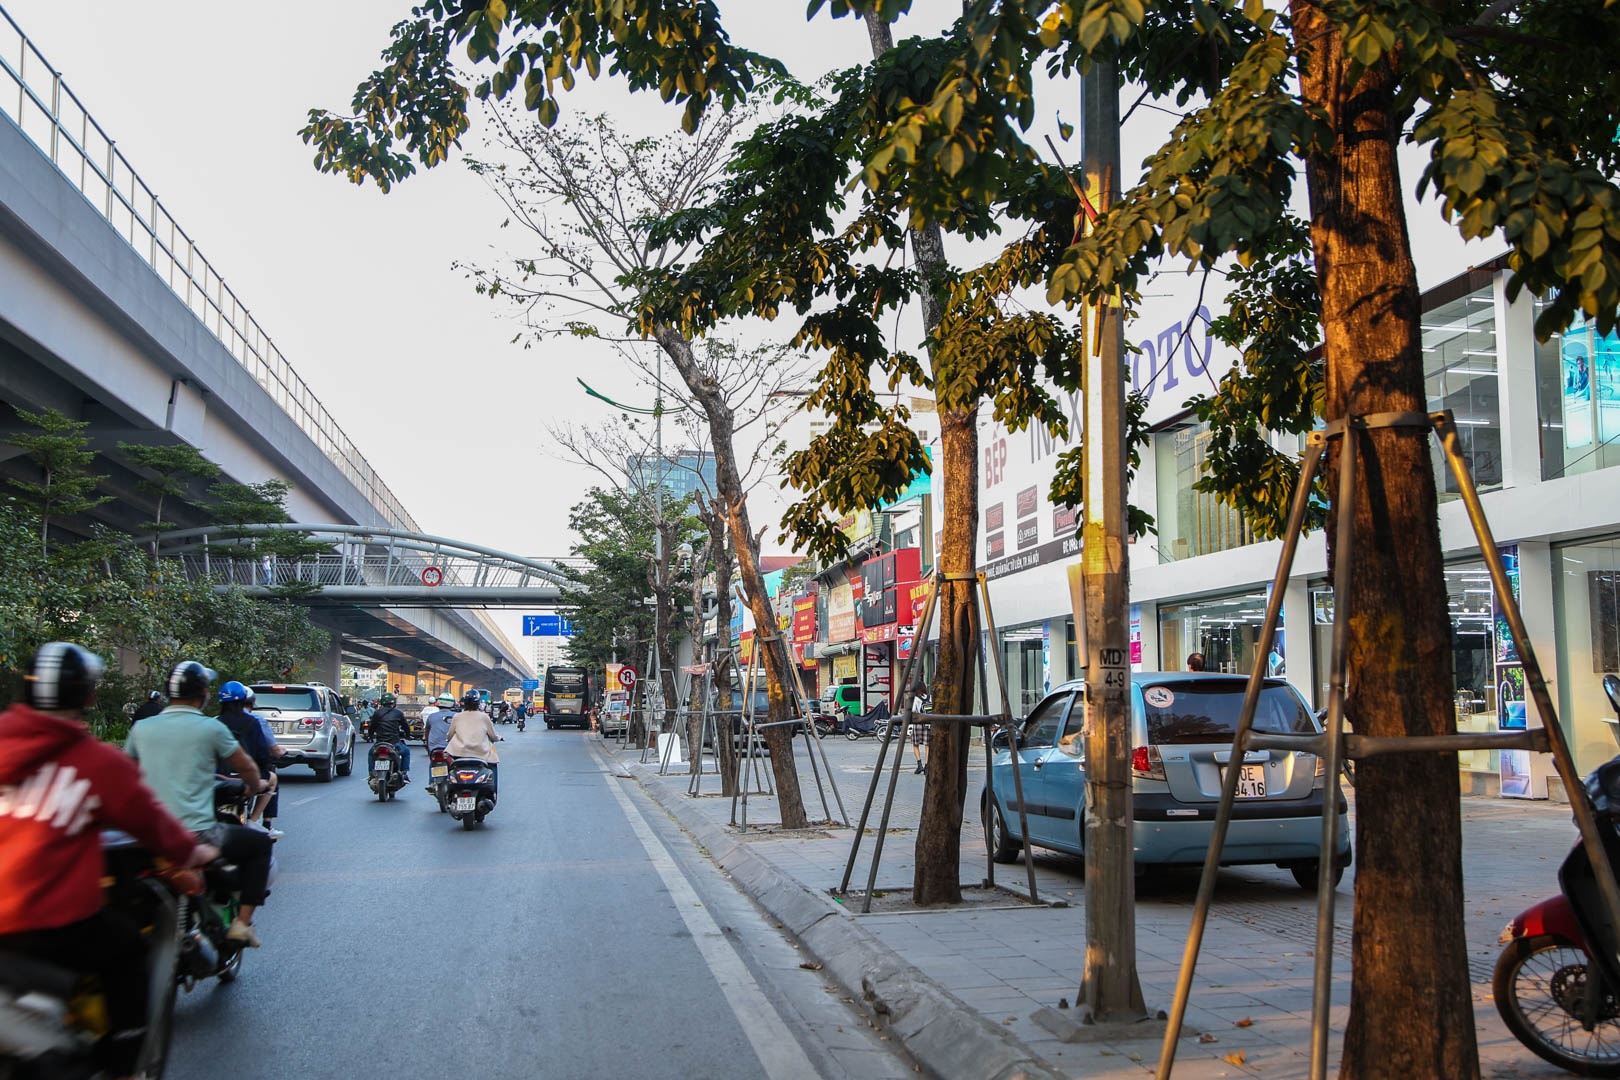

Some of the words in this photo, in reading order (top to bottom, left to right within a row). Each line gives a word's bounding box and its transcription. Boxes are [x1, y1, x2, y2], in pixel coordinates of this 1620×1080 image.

[1124, 305, 1213, 401] OTO
[985, 422, 1007, 489] BẾP
[1105, 671, 1125, 688] 4-9
[1240, 767, 1255, 782] 0E
